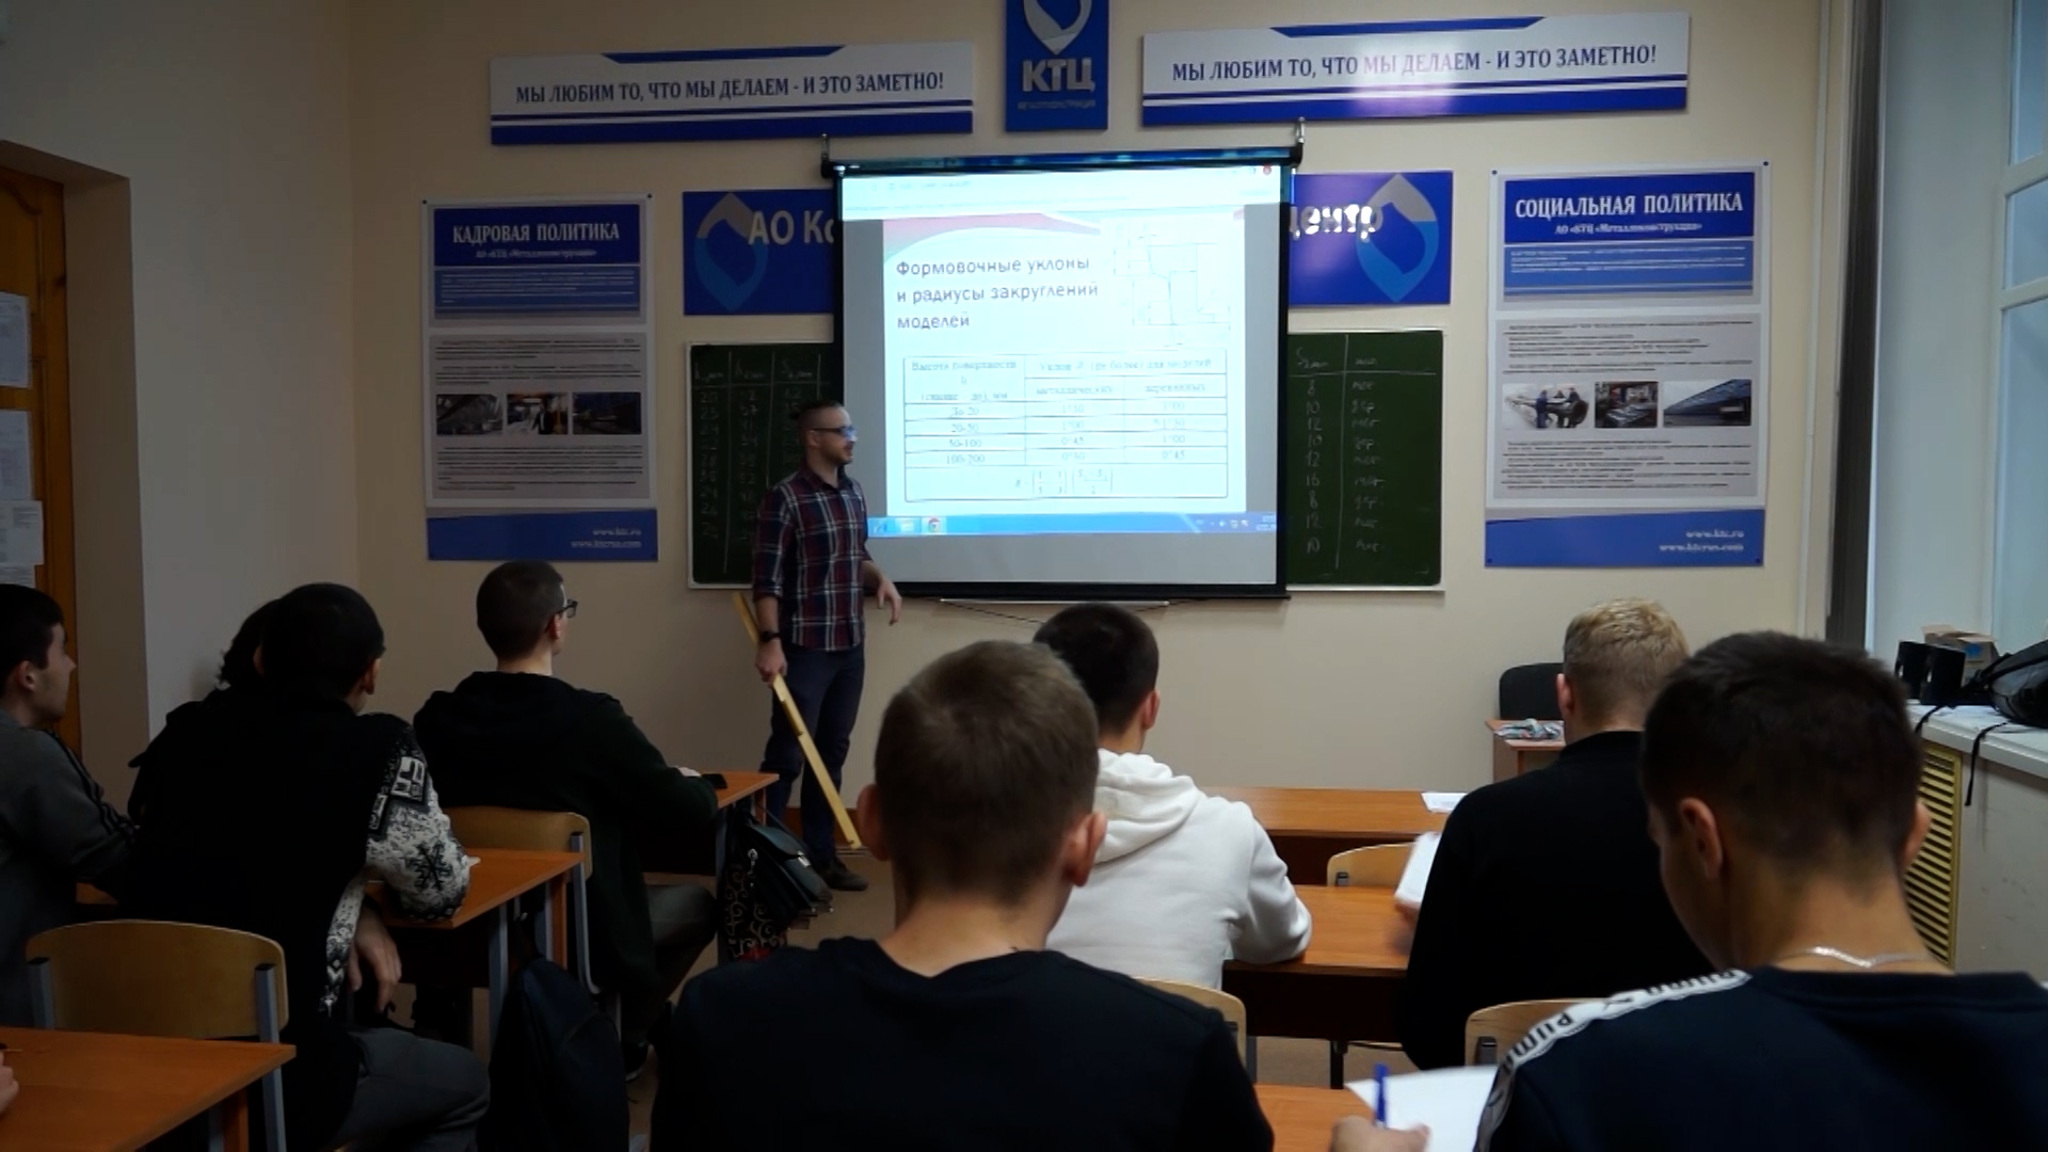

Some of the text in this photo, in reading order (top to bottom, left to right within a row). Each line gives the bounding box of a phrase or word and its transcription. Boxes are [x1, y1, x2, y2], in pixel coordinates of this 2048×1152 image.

[1022, 57, 1096, 93] КТЦ
[1172, 63, 1204, 81] МЫ
[1209, 59, 1282, 80] ЛЮБИМ
[1288, 58, 1317, 79] ТО,
[1322, 56, 1358, 75] ЧТО
[1363, 54, 1396, 74] МЫ
[1401, 52, 1480, 76] ДЕЛАЕМ
[1496, 50, 1509, 69] И
[1514, 48, 1551, 68] ЭТО
[1556, 44, 1657, 67] ЗАМЕТНО!
[515, 86, 545, 102] МЫ
[550, 83, 614, 101] ЛЮБИМ
[618, 82, 645, 102] ТО,
[648, 82, 681, 98] ЧТО
[685, 80, 715, 98] МЫ
[719, 77, 788, 100] ДЕЛАЕМ
[803, 76, 815, 94] И
[819, 75, 851, 93] ЭТО
[856, 71, 944, 92] ЗАМЕТНО!
[1515, 192, 1744, 221] СОЦИАЛЬНАЯ ПОЛИТИКА
[453, 222, 620, 247] КАДРОВАЯ ПОЛИТИКА
[748, 210, 795, 245] АО
[896, 257, 1090, 278] Формовочные уклоны
[897, 280, 1099, 305] и радиусы закруглений
[897, 311, 970, 330] моделей
